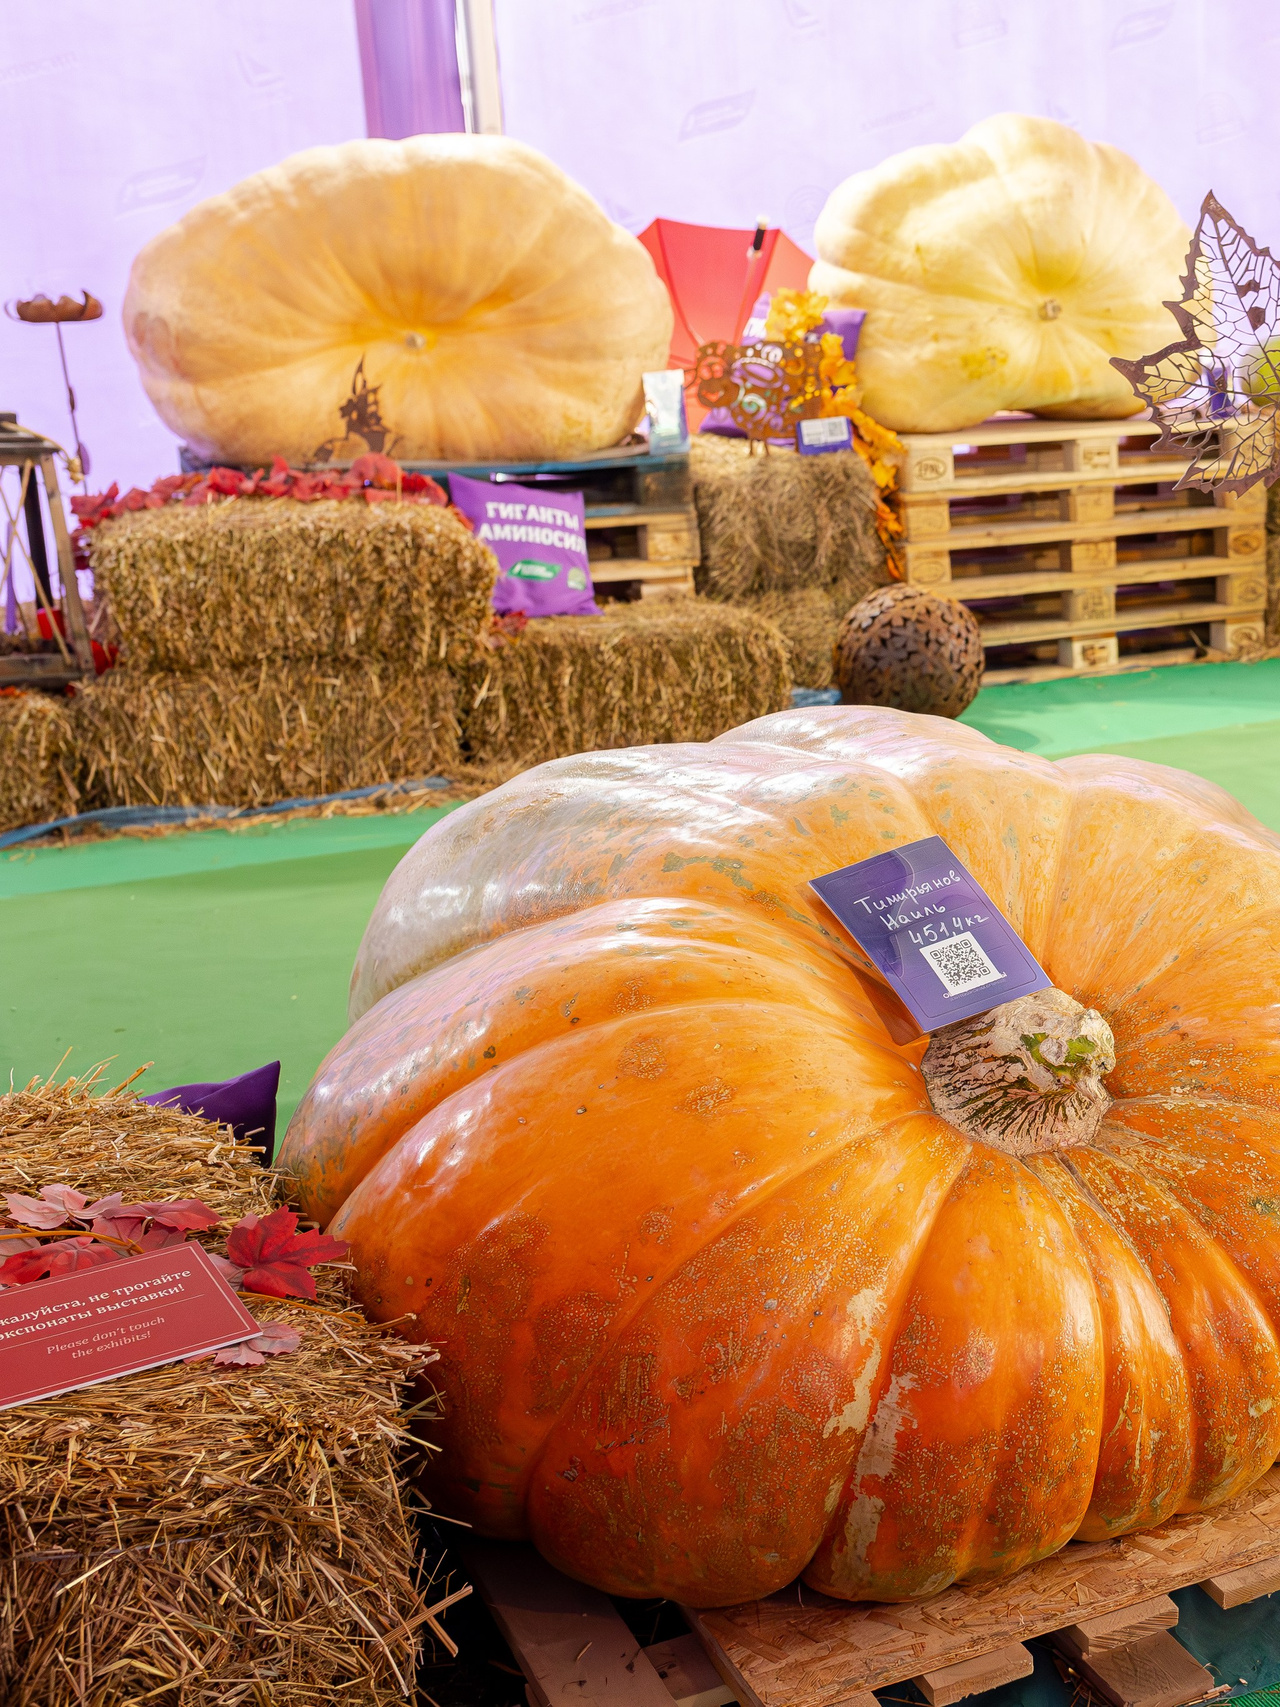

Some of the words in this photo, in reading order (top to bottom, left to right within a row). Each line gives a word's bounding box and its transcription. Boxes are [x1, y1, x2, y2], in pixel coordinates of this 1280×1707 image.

[485, 501, 580, 531] ГИГАНТЫ
[853, 870, 961, 914] Тимирьянов
[879, 904, 946, 931] Наиль
[88, 1292, 110, 1303] не
[112, 1270, 192, 1296] трогайте
[96, 1283, 185, 1314] выставки!
[47, 1338, 89, 1354] Please
[129, 1316, 165, 1332] touch
[72, 1348, 93, 1359] the
[96, 1331, 151, 1352] exhibits!
